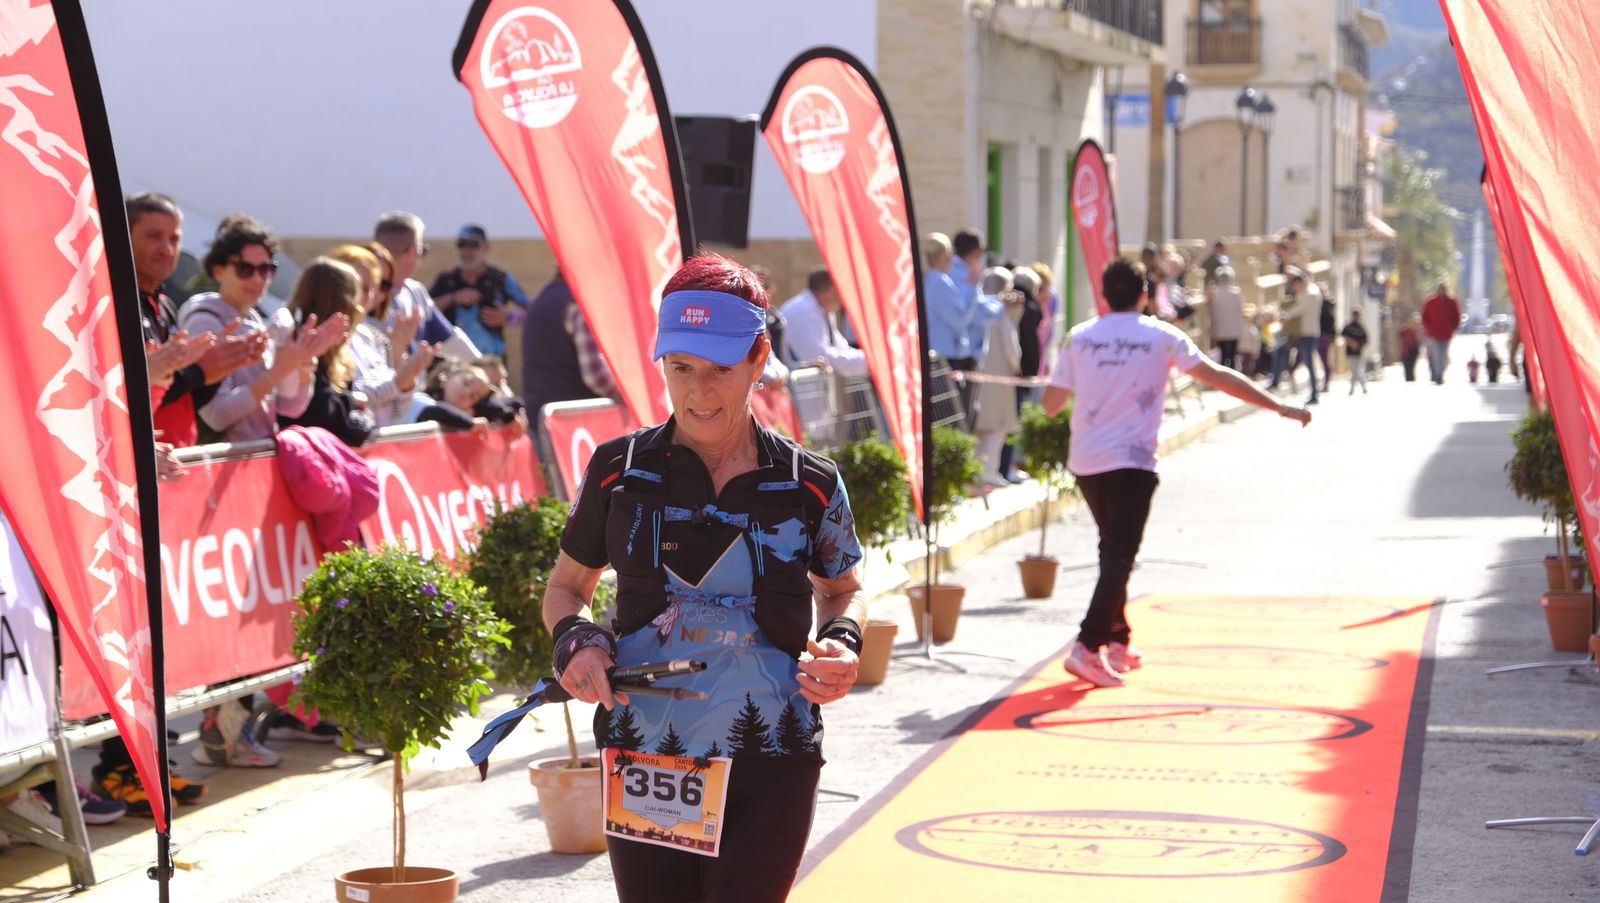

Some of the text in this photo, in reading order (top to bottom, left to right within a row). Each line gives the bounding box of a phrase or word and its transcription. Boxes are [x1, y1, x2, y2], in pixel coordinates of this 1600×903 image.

[680, 315, 710, 325] HAPPY
[686, 308, 705, 317] RUN
[630, 503, 644, 541] RAIDLIGHT
[160, 520, 317, 626] VEOLIA
[625, 767, 703, 806] 356
